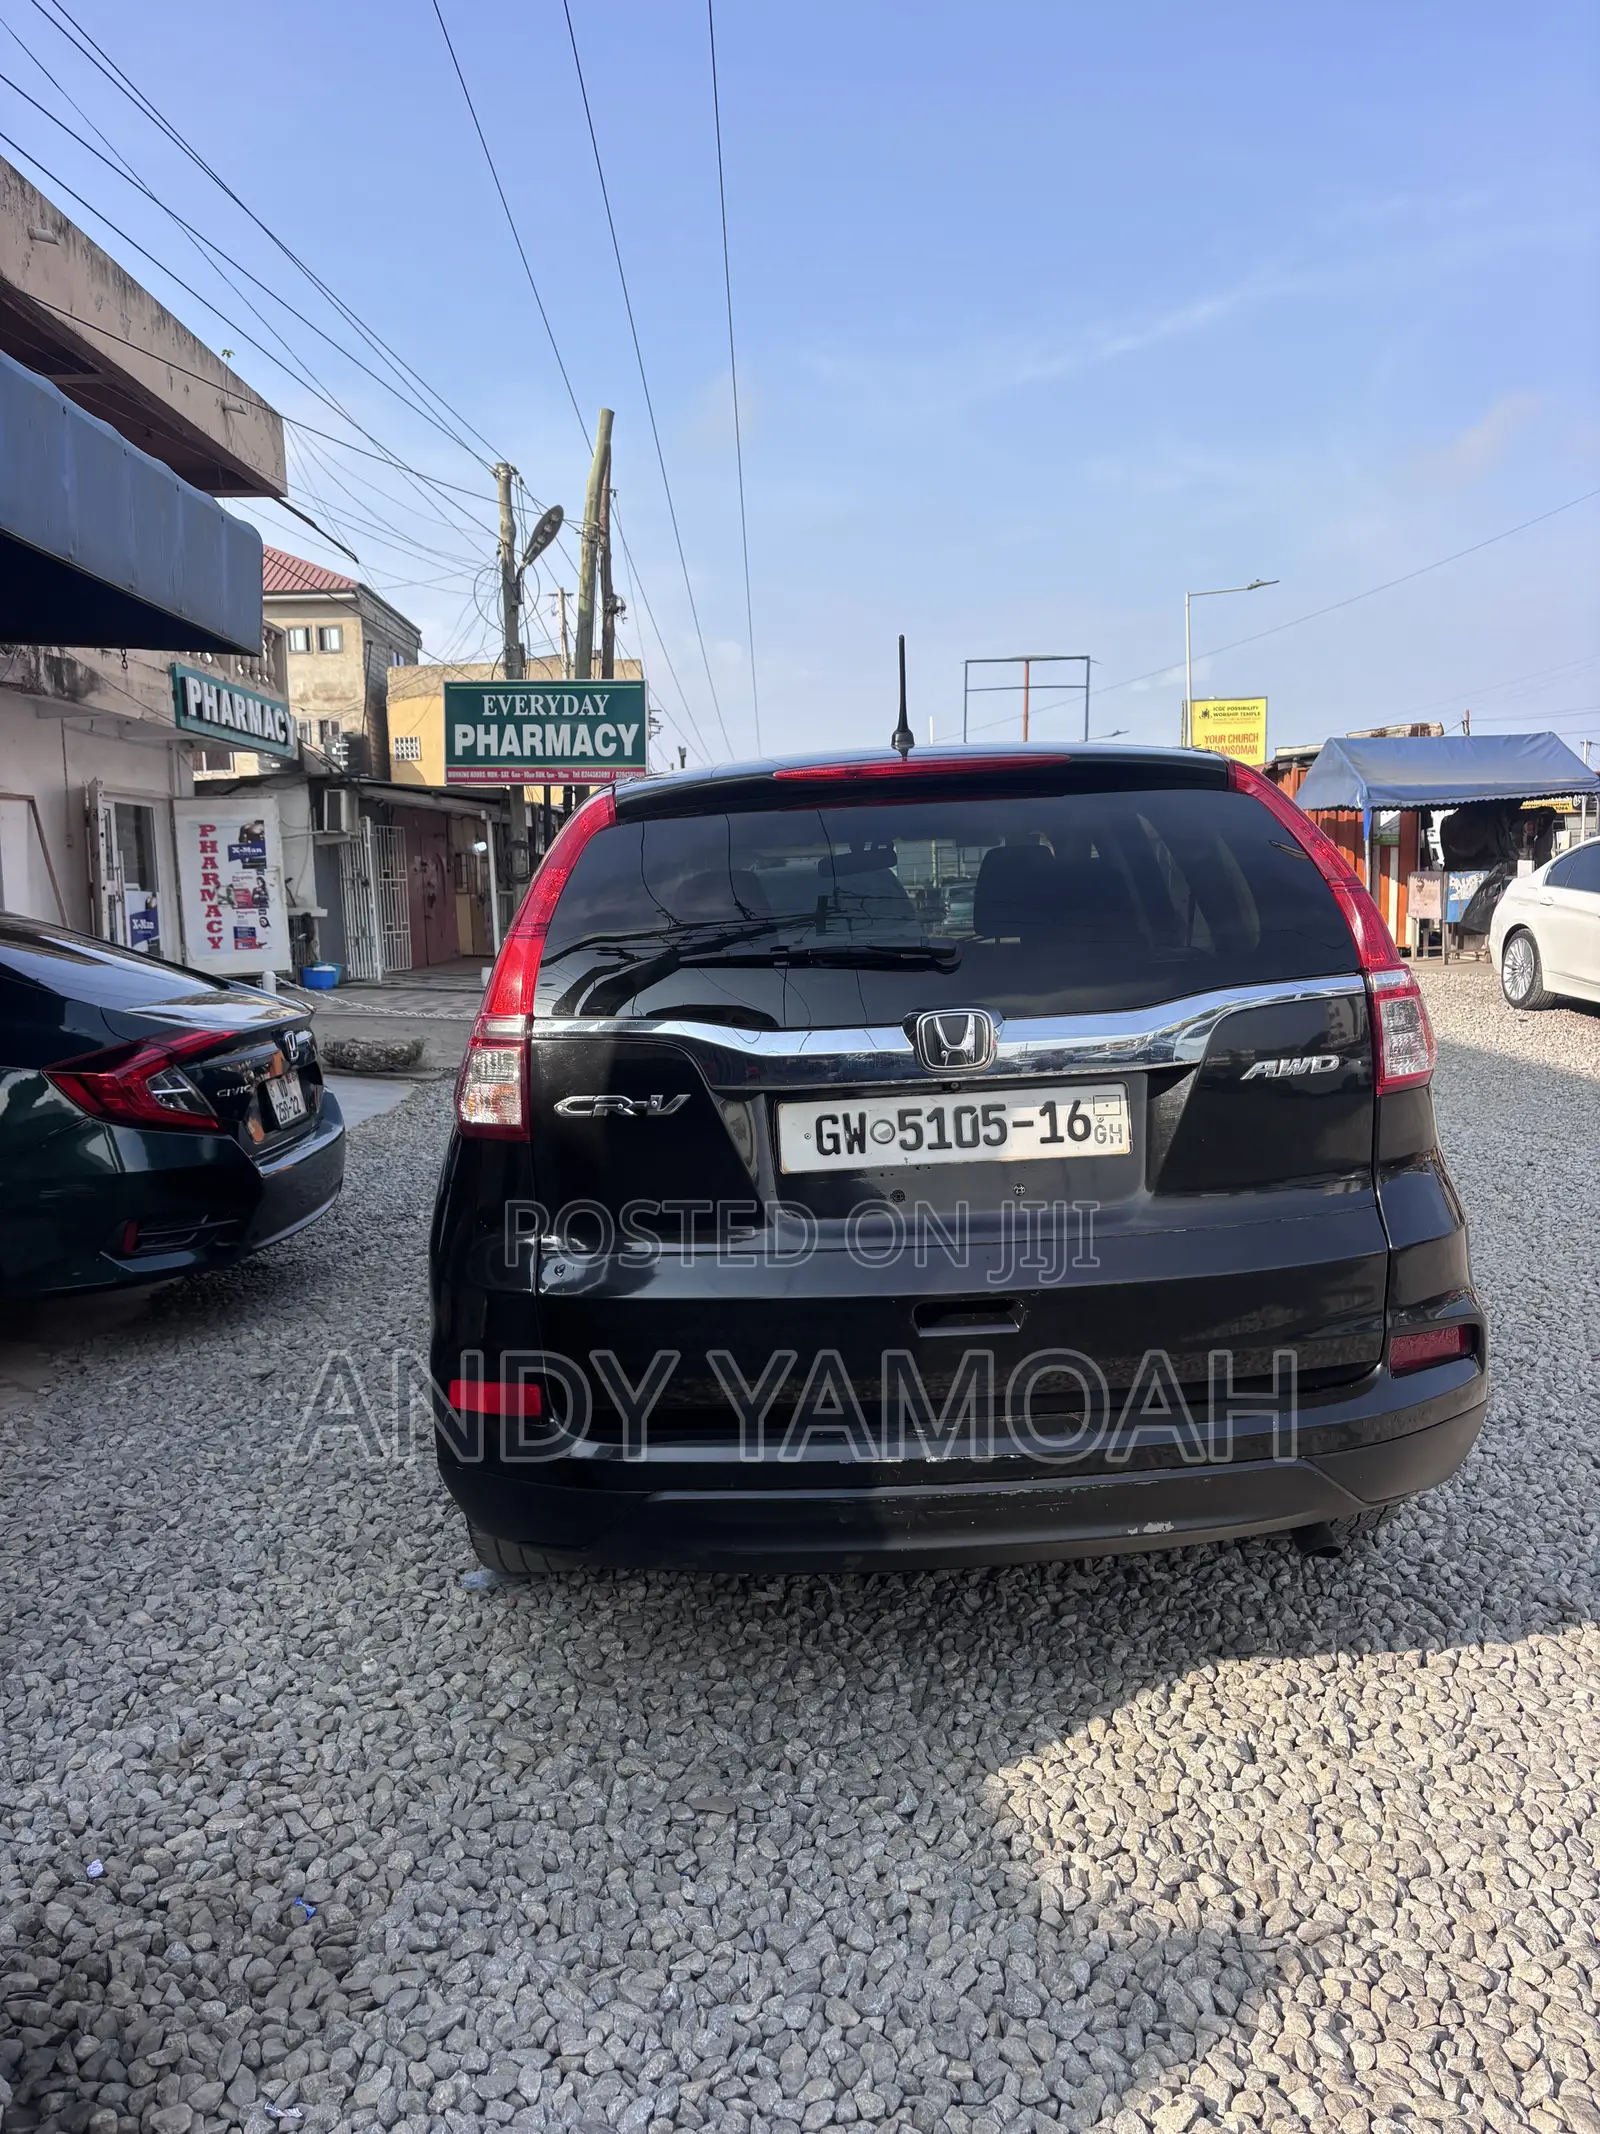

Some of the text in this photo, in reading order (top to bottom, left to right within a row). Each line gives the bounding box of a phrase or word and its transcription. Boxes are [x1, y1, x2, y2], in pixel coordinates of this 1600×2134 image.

[185, 676, 296, 746] PHARMACY
[482, 694, 610, 716] EVERYDAY
[454, 723, 640, 757] PHARMACY
[1204, 733, 1259, 745] YOUR CHURCH
[231, 846, 263, 854] X-Man
[199, 823, 223, 950] PHARMACY
[131, 918, 155, 930] X-Man
[1240, 1054, 1340, 1081] AWD
[216, 1084, 252, 1098] CIVIC
[553, 1093, 691, 1117] CR-V
[815, 1099, 1092, 1156] GW 5105-16
[1094, 1123, 1122, 1145] GH
